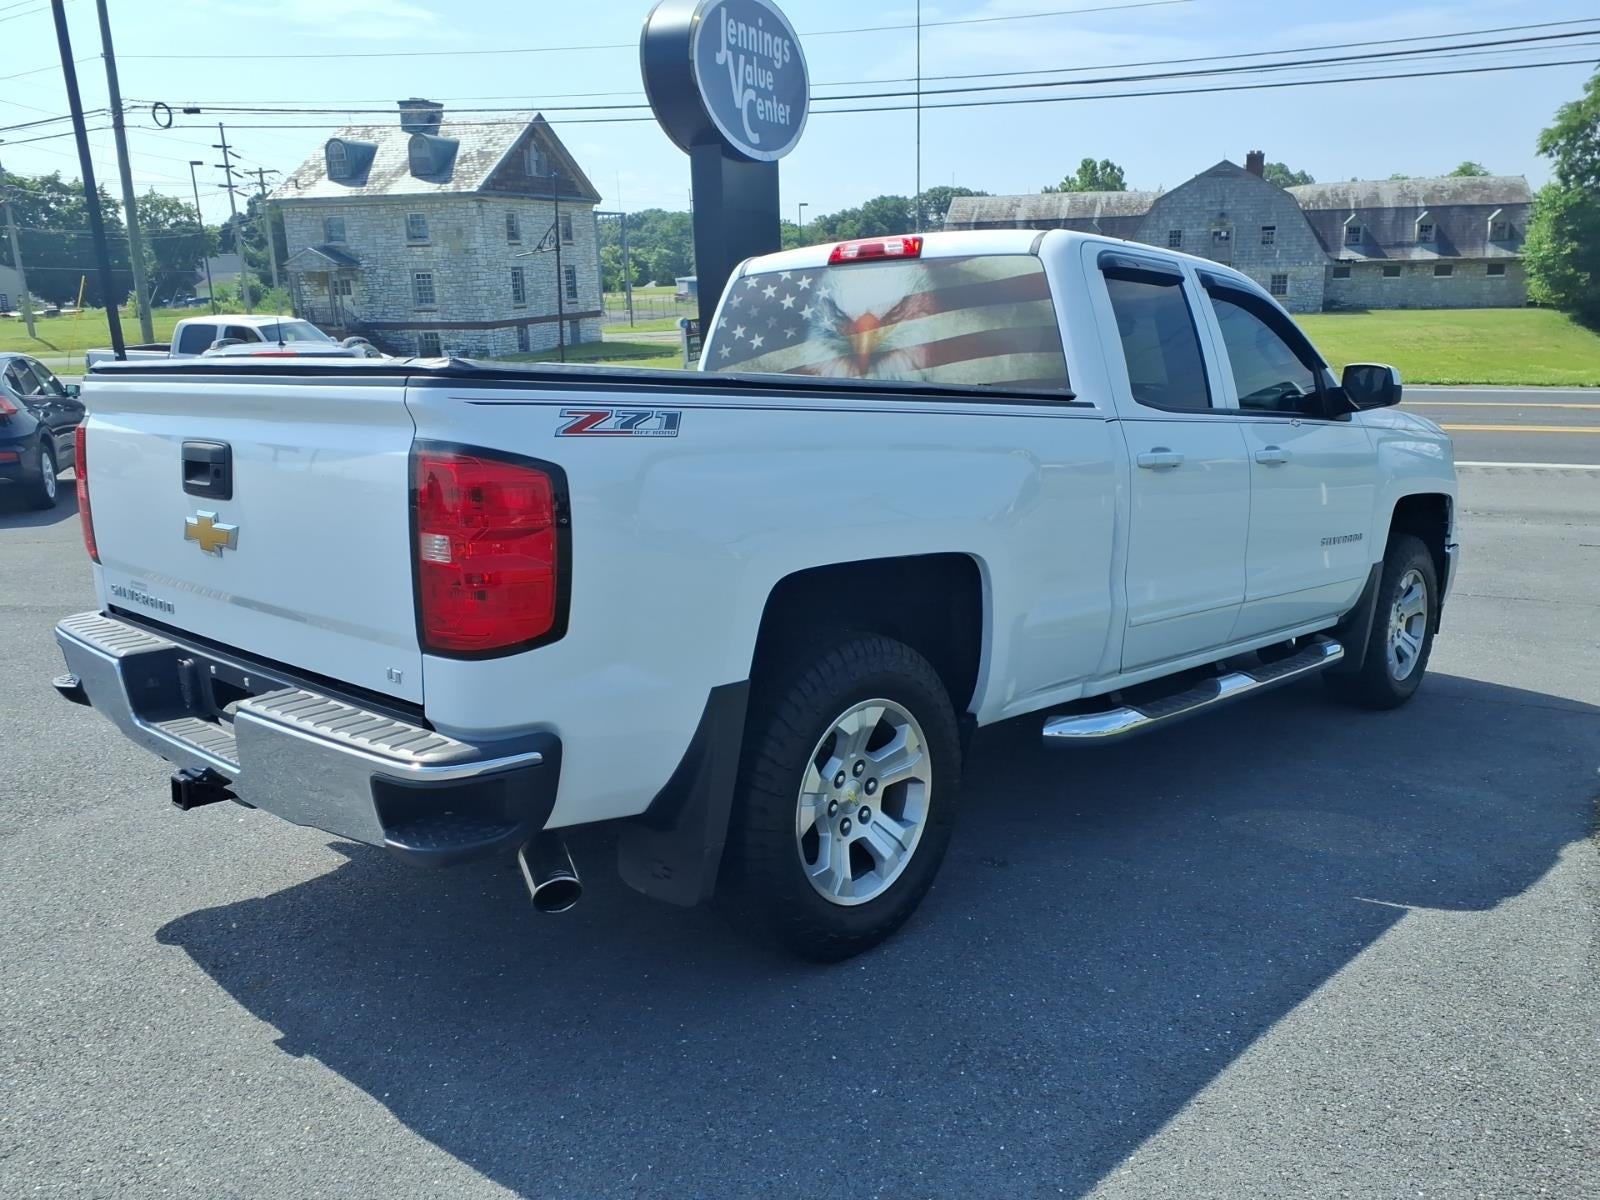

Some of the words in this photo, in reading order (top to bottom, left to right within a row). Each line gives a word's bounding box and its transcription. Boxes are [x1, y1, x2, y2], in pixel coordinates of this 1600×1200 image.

[715, 6, 791, 69] Jennings
[726, 51, 774, 109] Value
[741, 88, 791, 144] Center
[555, 408, 682, 437] Z71
[110, 583, 175, 614] SILVERADO
[387, 667, 402, 685] LT
